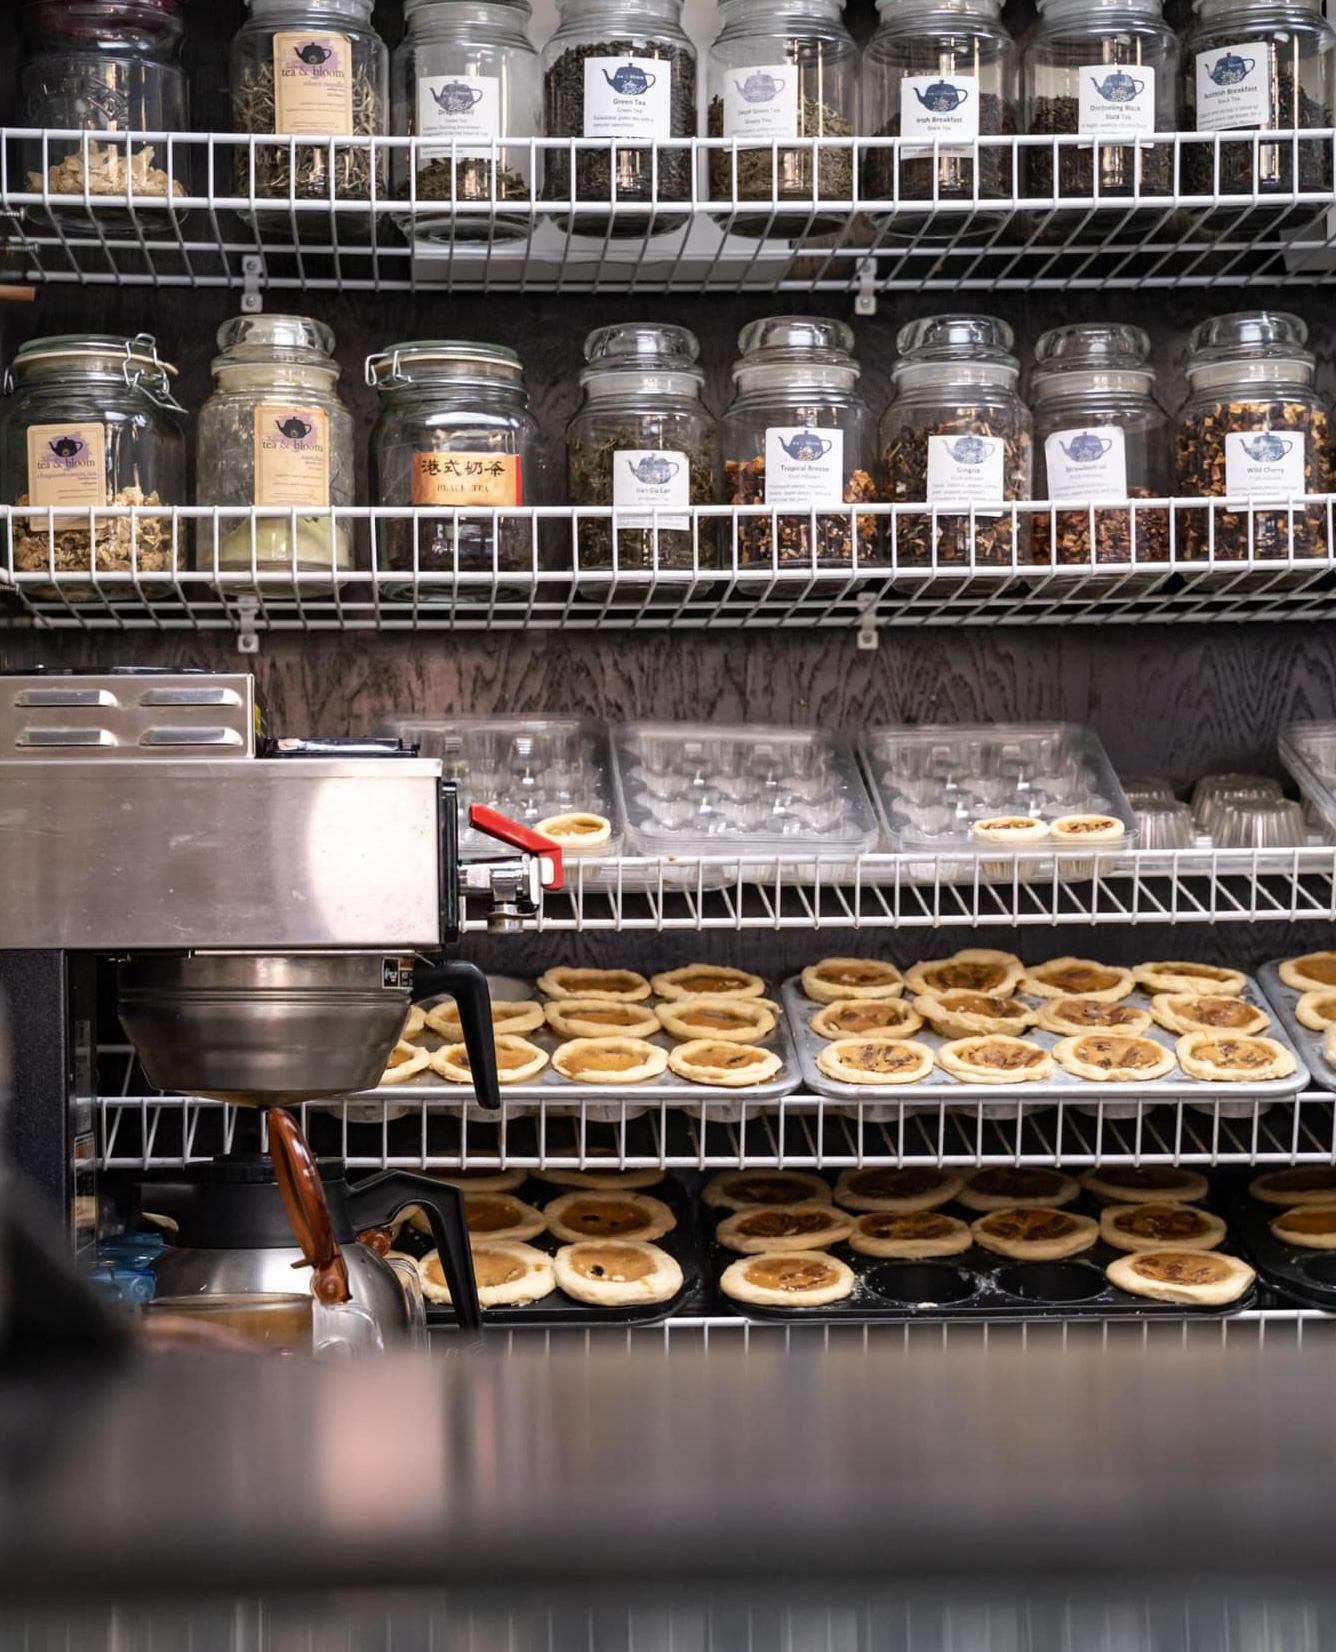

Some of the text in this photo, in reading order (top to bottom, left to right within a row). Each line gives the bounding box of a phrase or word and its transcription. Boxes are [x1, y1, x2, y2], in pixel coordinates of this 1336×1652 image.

[281, 65, 345, 78] tea & bloom
[1226, 86, 1258, 95] Breakfast
[262, 440, 324, 453] tea & bloom
[37, 458, 96, 470] tea & bloom
[421, 459, 506, 477] 港式奶茶
[780, 464, 807, 472] Tropical
[436, 484, 490, 493] BLACK TEA
